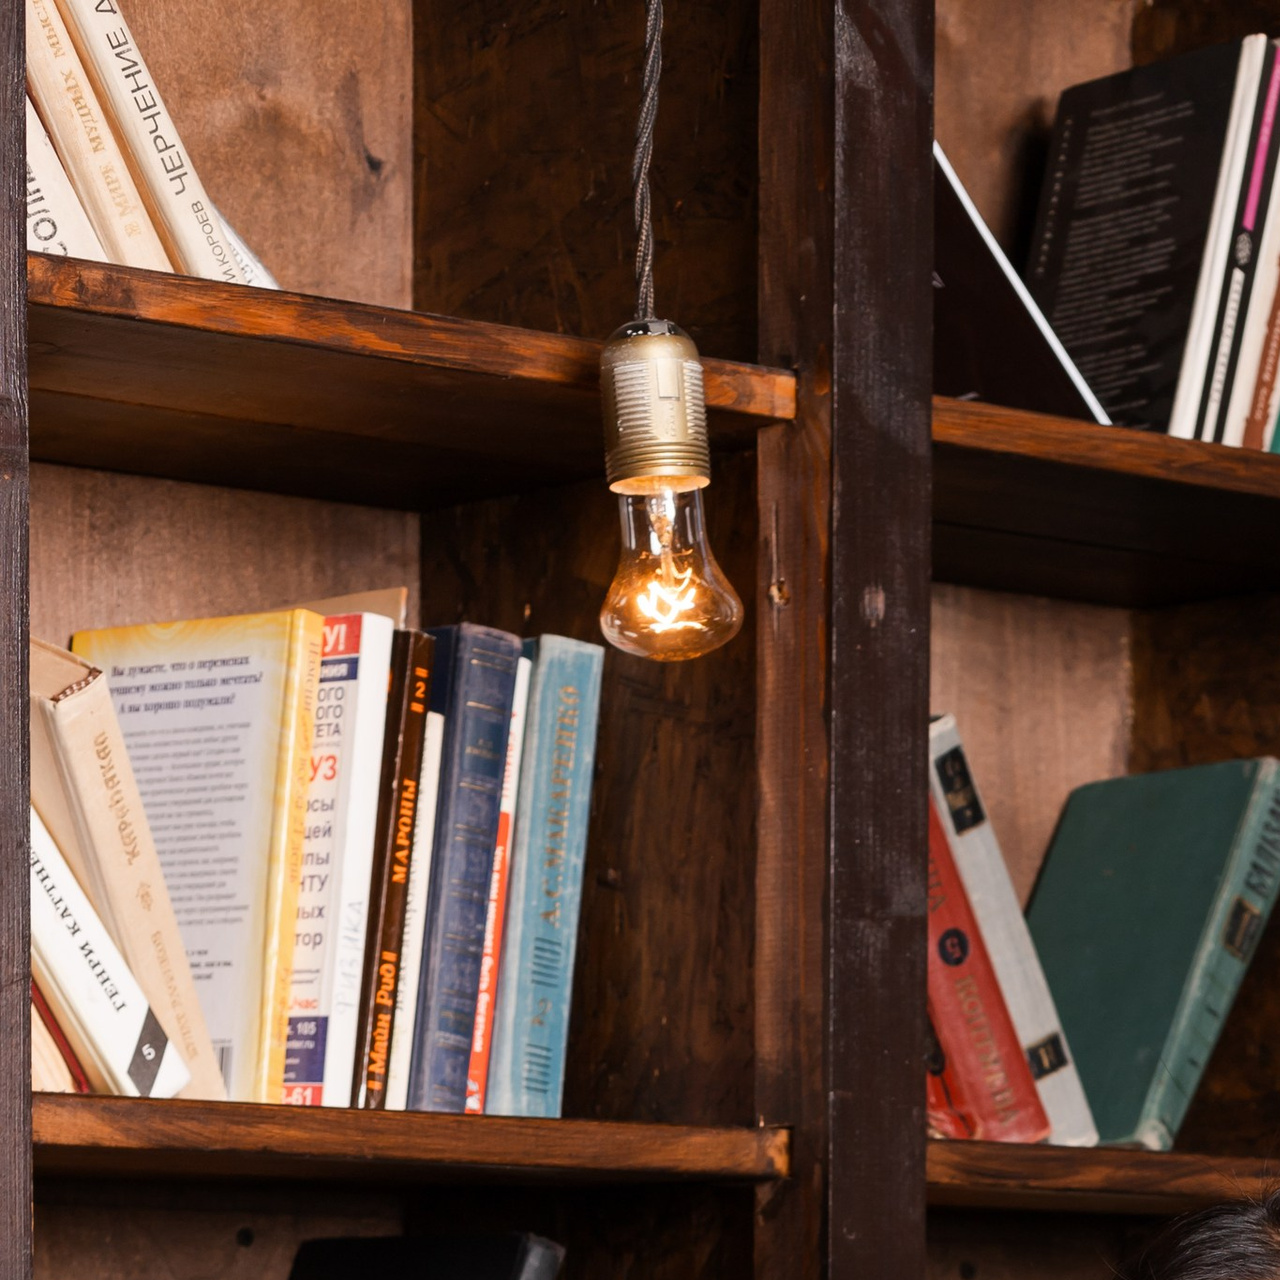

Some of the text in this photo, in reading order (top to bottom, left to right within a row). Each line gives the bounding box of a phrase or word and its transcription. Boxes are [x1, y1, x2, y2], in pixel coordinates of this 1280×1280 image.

[106, 27, 190, 197] ЧЕРЧЕНИЕ
[415, 681, 427, 699] 2
[391, 778, 417, 884] МАРОНЫ
[30, 842, 127, 1013] ГЕНРИ КАТТНЕ
[140, 1042, 157, 1061] 5
[367, 961, 397, 1075] Майн Рид
